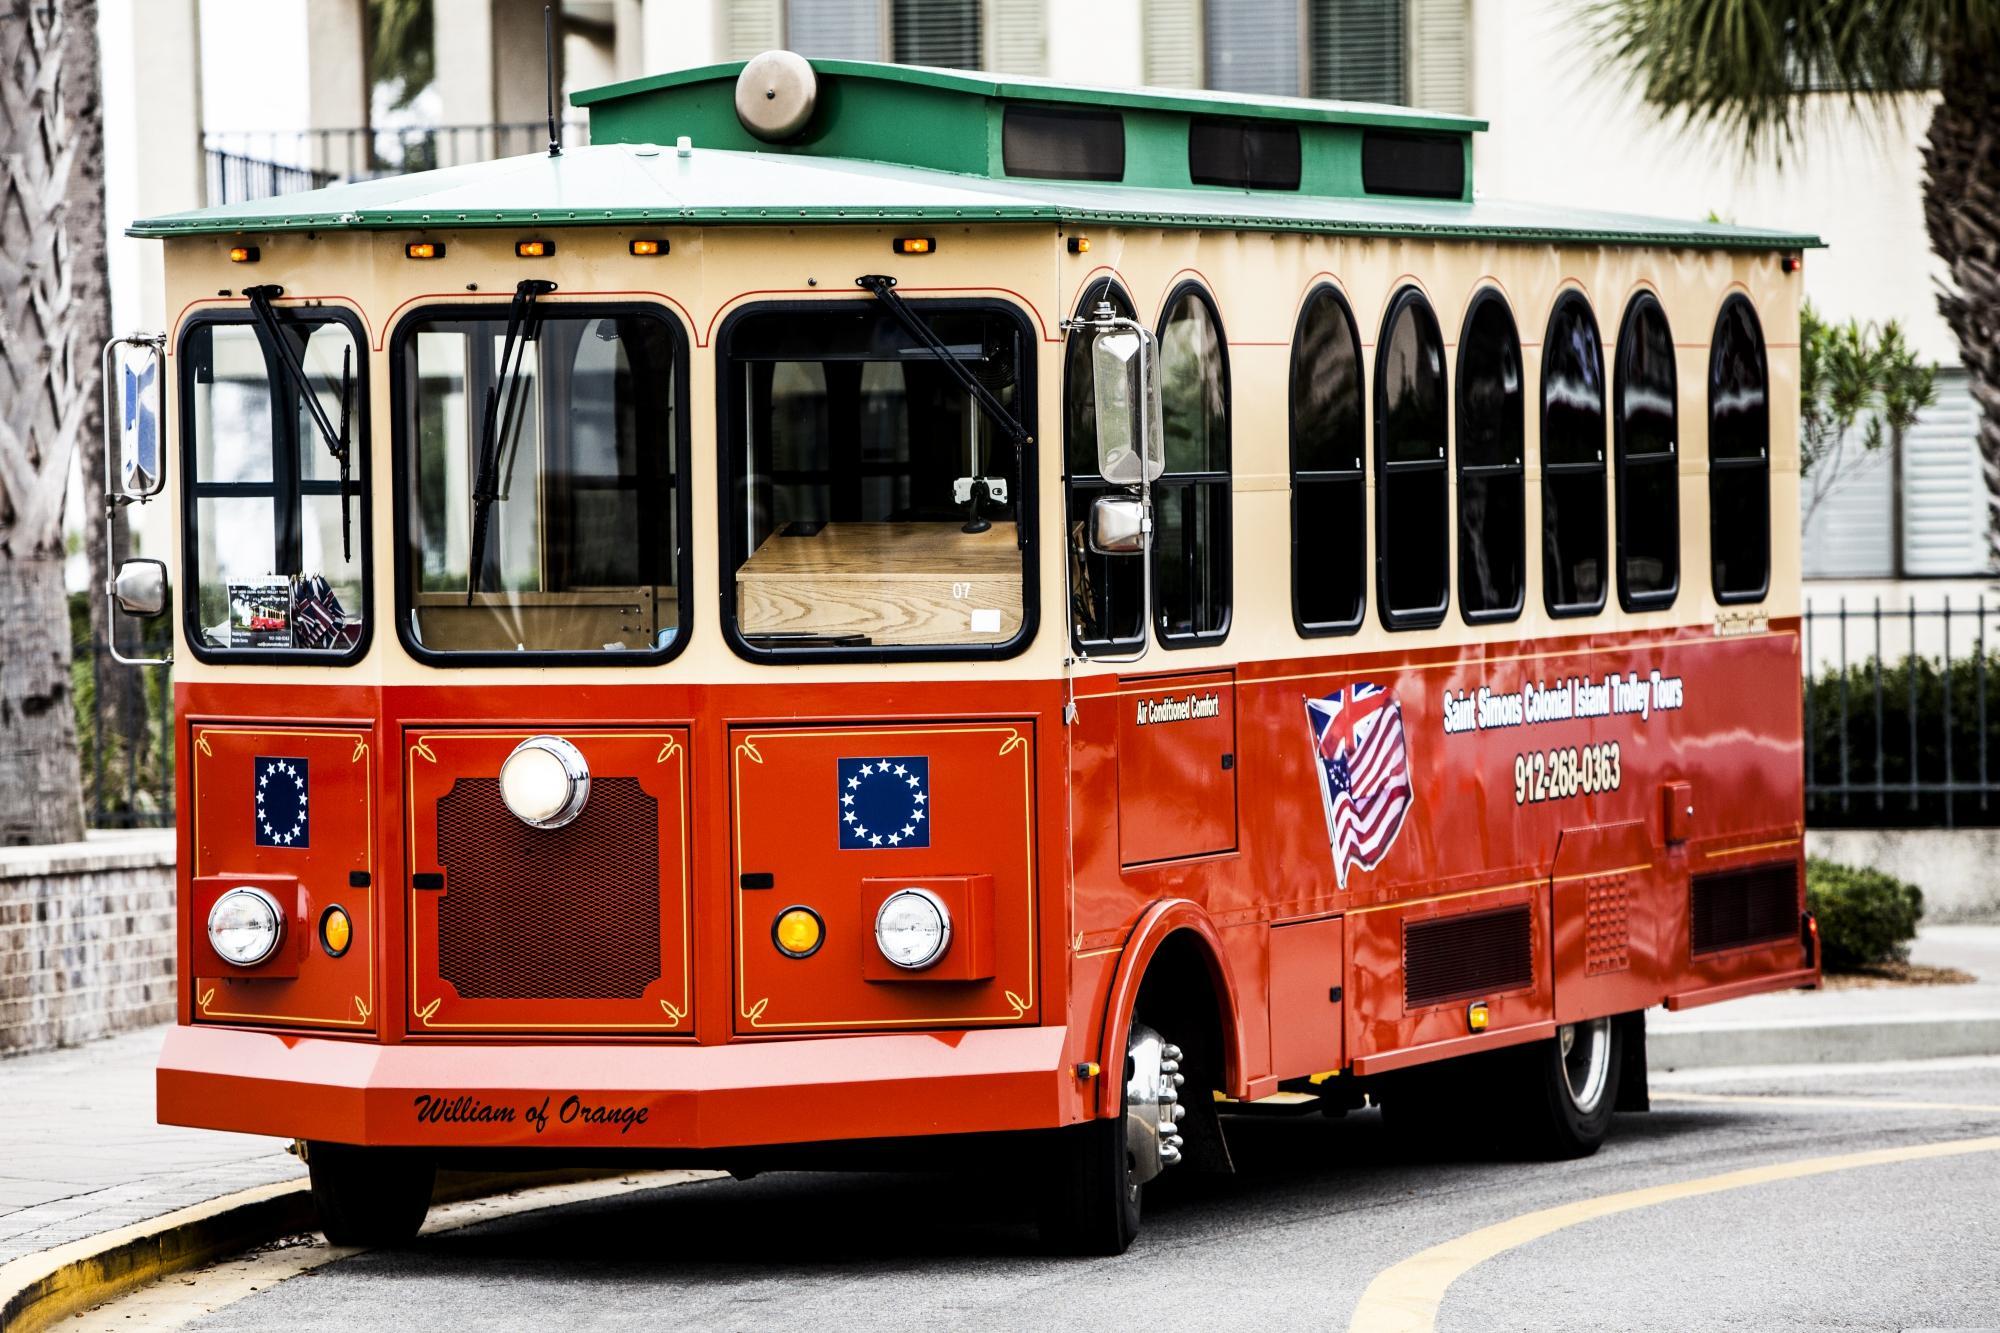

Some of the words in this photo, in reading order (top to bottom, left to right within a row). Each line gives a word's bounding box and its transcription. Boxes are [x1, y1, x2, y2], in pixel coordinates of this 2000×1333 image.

[953, 583, 971, 599] 07
[1137, 699, 1148, 725] Air
[1148, 695, 1190, 723] Conditioned
[1191, 692, 1219, 718] Comfort
[1443, 689, 1476, 733] Saint
[1477, 686, 1522, 730] Simons
[1524, 680, 1572, 723] Colonial
[1574, 675, 1609, 718] Island
[1611, 671, 1650, 721] Trolley
[1651, 669, 1683, 711] Tours
[1515, 741, 1621, 804] 912-268-0363
[414, 1094, 516, 1123] William
[525, 1096, 550, 1133] of
[559, 1094, 649, 1134] Orange
